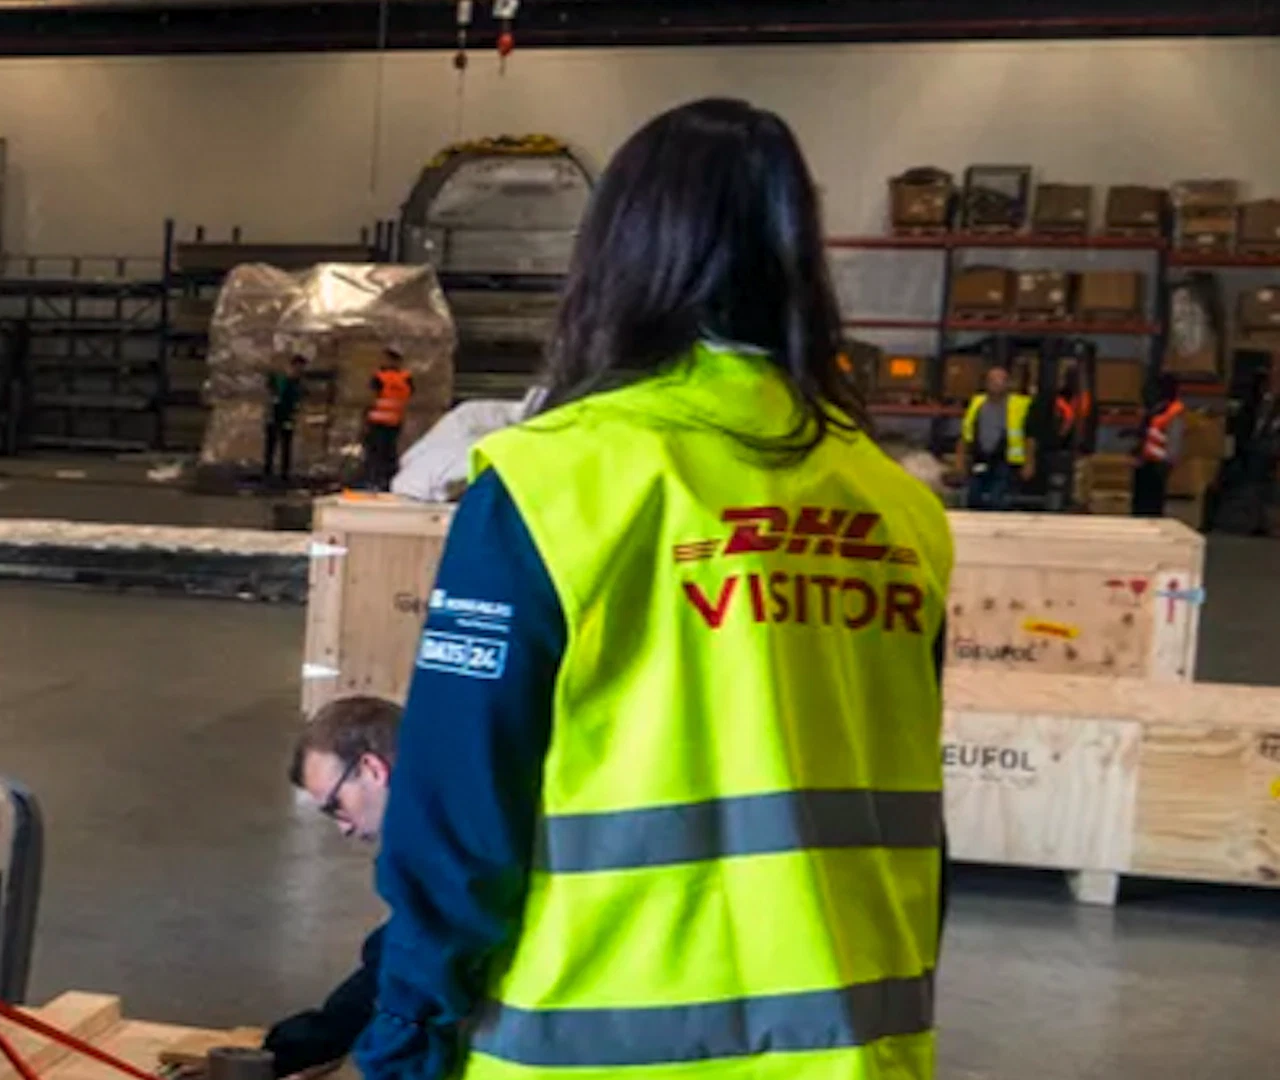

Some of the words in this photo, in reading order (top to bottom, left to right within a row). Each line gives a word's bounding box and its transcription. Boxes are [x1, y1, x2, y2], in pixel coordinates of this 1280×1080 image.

[721, 505, 888, 561] DHL
[682, 570, 925, 635] VISITOR
[469, 645, 496, 669] 24
[943, 743, 1036, 771] EUFOL
